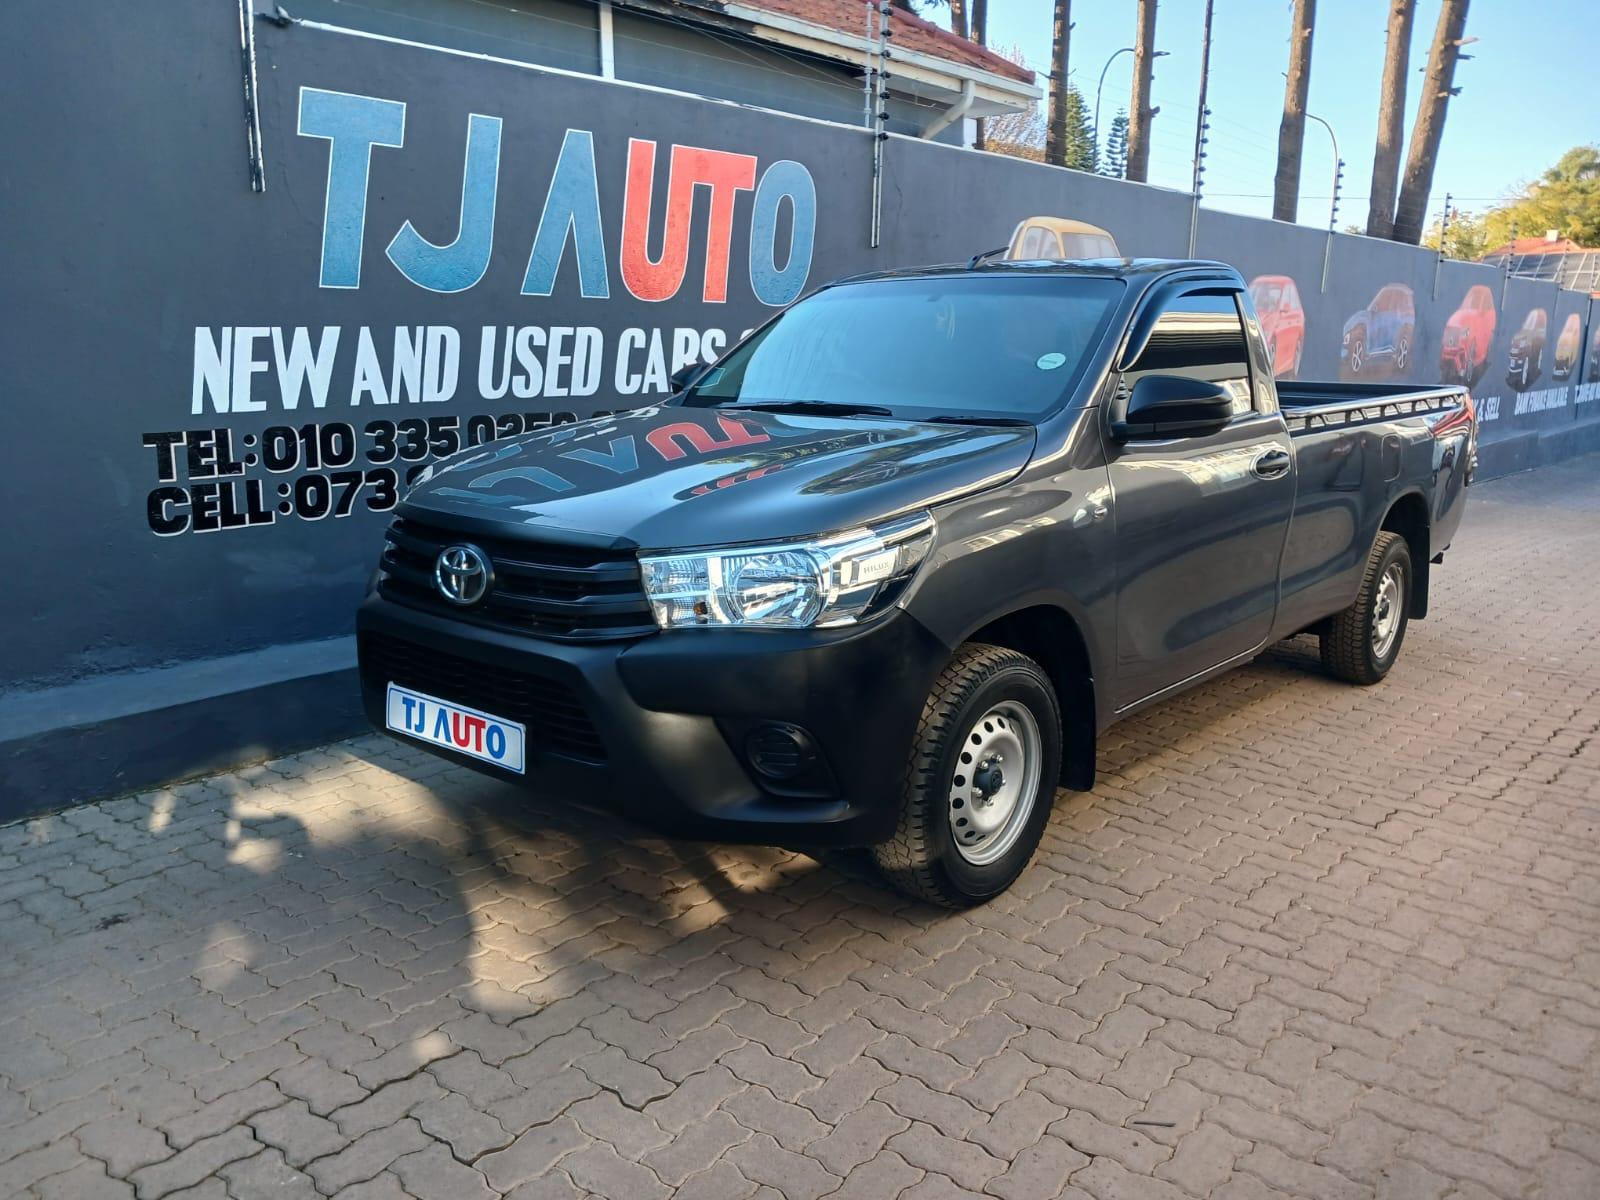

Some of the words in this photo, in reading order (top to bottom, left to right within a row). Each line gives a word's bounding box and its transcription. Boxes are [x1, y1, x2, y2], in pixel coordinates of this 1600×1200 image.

[298, 86, 503, 293] TJ
[520, 128, 817, 307] AUTO
[191, 326, 341, 415] NEW
[350, 325, 461, 406] AND
[478, 325, 603, 399] USED
[364, 408, 461, 465] 335
[863, 562, 889, 574] HILUX
[402, 696, 426, 734] TJ
[433, 707, 506, 760] AUTO
